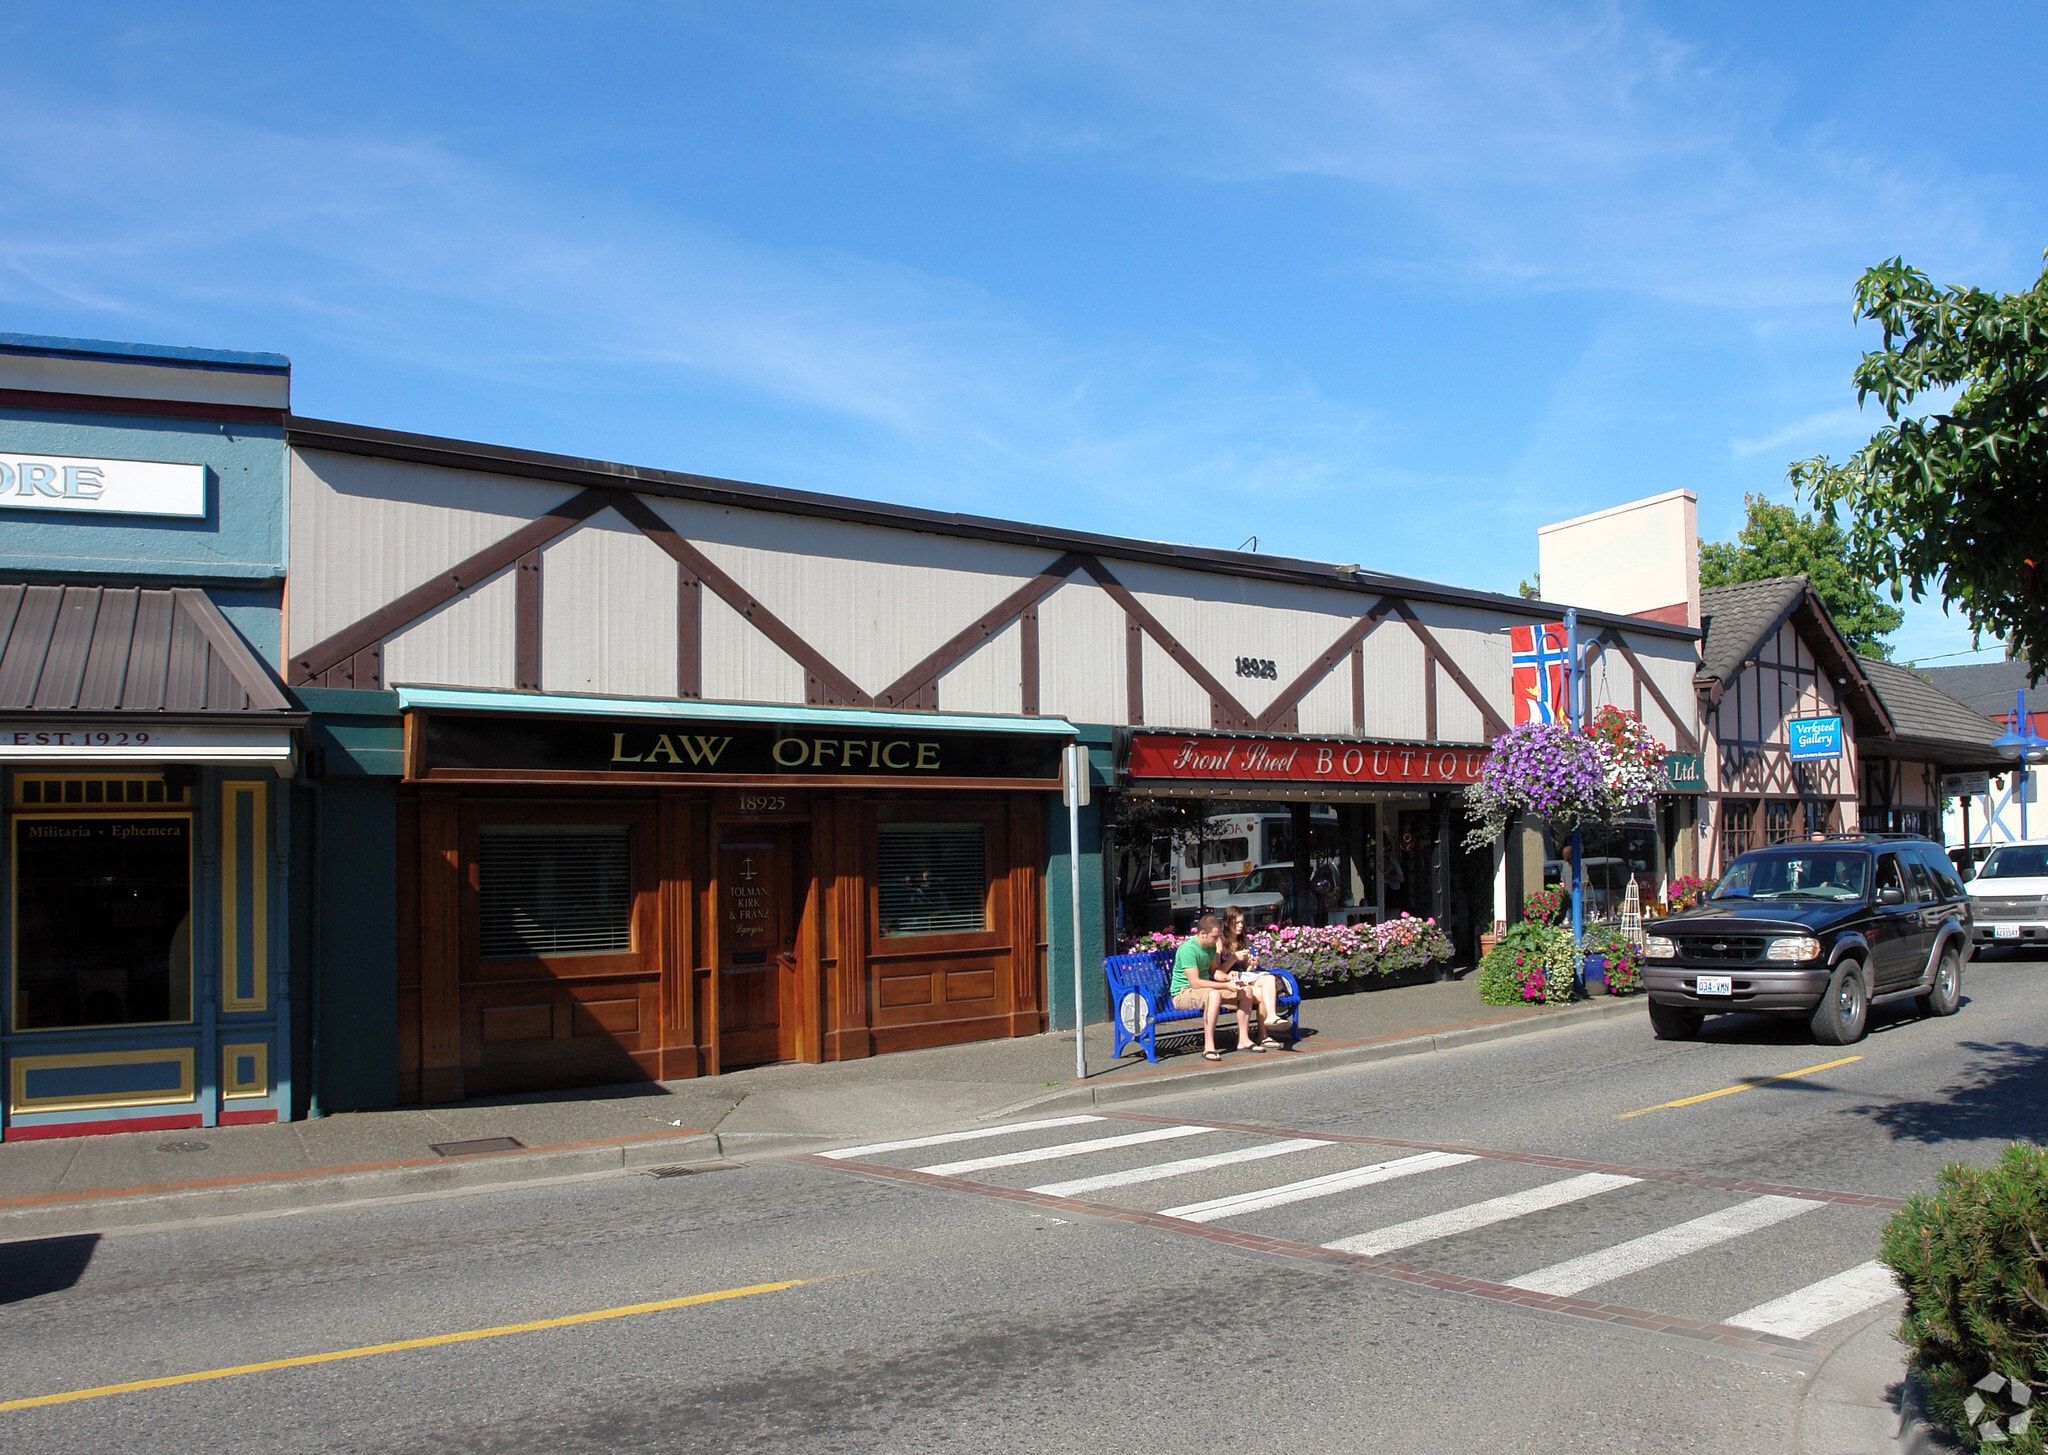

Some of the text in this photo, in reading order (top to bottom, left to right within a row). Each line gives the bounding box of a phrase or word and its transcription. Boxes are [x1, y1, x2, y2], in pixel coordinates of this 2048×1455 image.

[1234, 655, 1278, 681] 18925
[14, 732, 150, 746] EST. 1929
[1798, 733, 1833, 748] Gallery
[611, 732, 942, 770] LAW OFFICE
[1173, 740, 1483, 780] Front Street BOUTIQU
[1673, 759, 1699, 782] Ltd.
[738, 795, 786, 811] 18925
[29, 825, 181, 839] Militaria Ephemera
[730, 886, 768, 897] TOLMAN
[738, 898, 760, 908] KIRK
[740, 910, 769, 920] FRANZ
